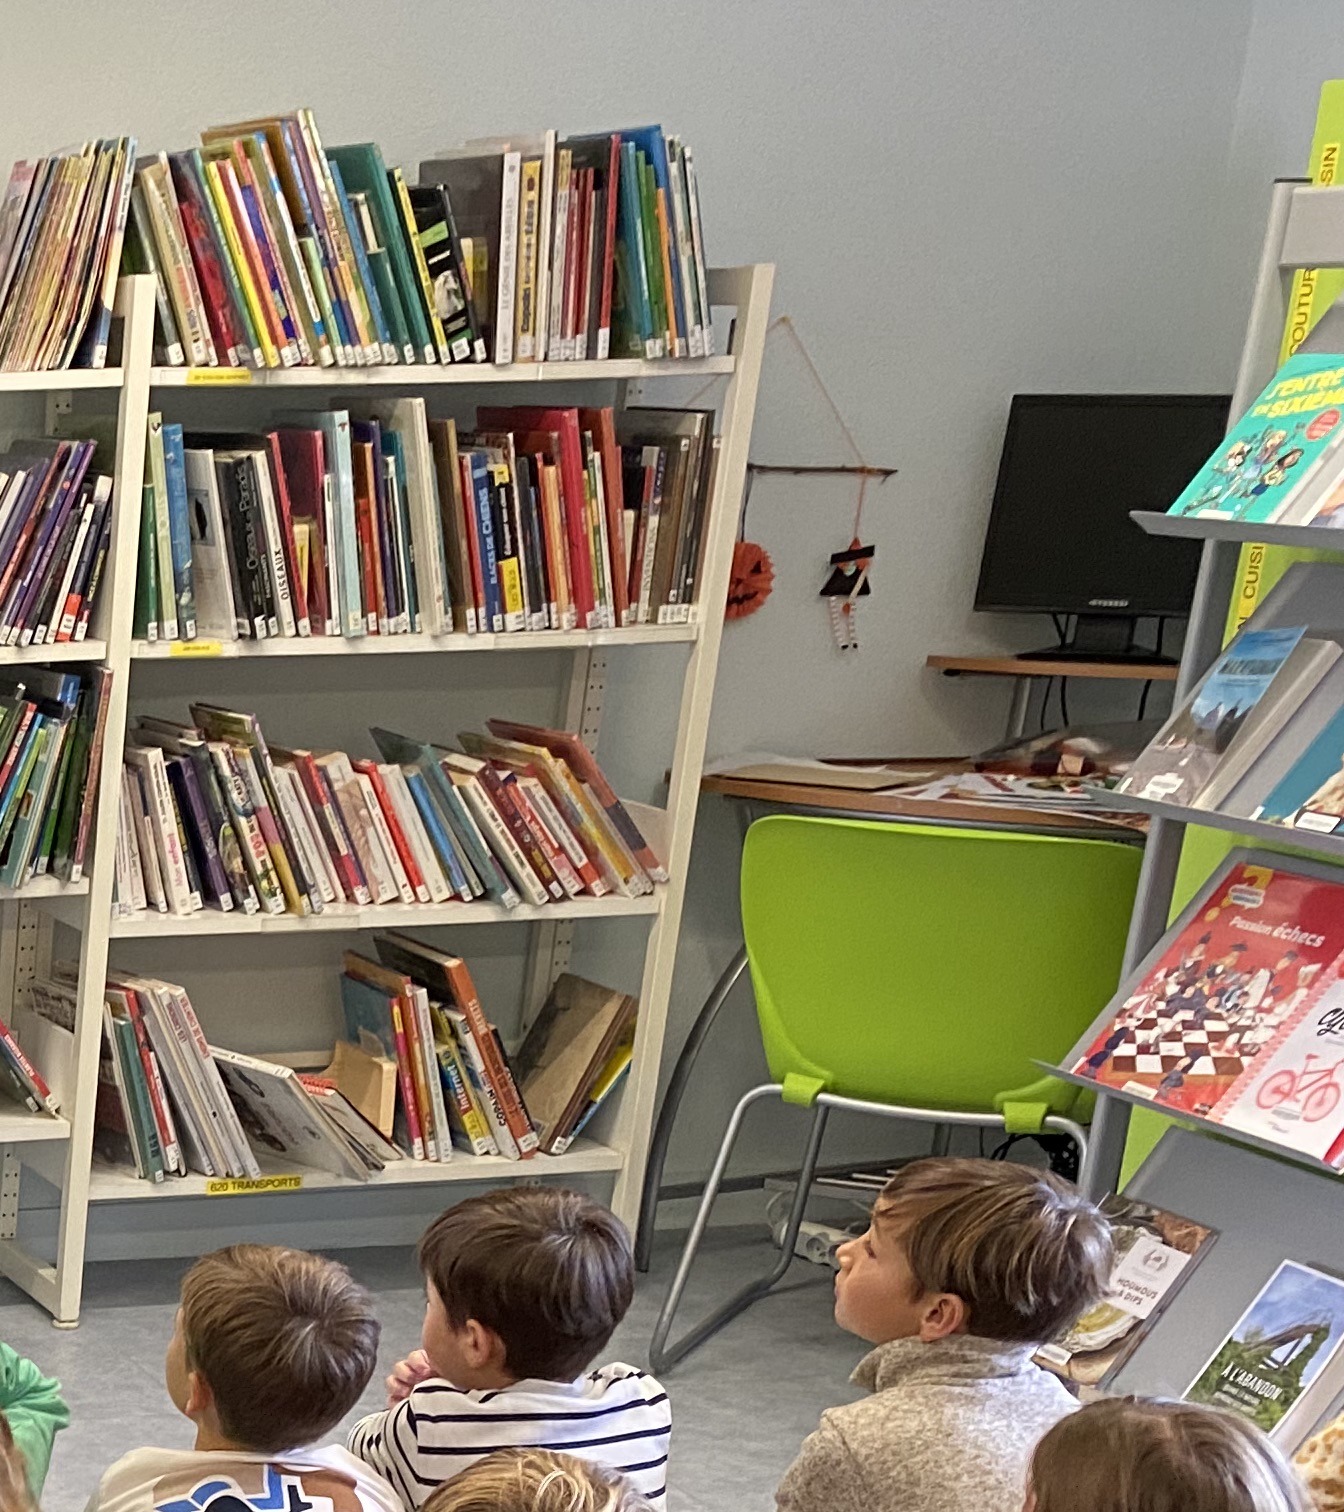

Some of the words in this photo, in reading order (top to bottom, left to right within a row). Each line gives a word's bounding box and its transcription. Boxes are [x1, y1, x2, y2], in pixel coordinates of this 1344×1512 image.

[273, 548, 289, 600] OISEAUX
[166, 832, 179, 865] enfant
[1229, 916, 1272, 936] Passion
[1272, 921, 1326, 948] échecs
[443, 1063, 471, 1110] Internet
[485, 1088, 507, 1127] COPAIN
[232, 1176, 301, 1190] TRANSPORTS
[1116, 1278, 1158, 1300] HOUMOUS
[1124, 1292, 1144, 1306] DIPS
[1230, 1368, 1284, 1400] L'ABANDON
